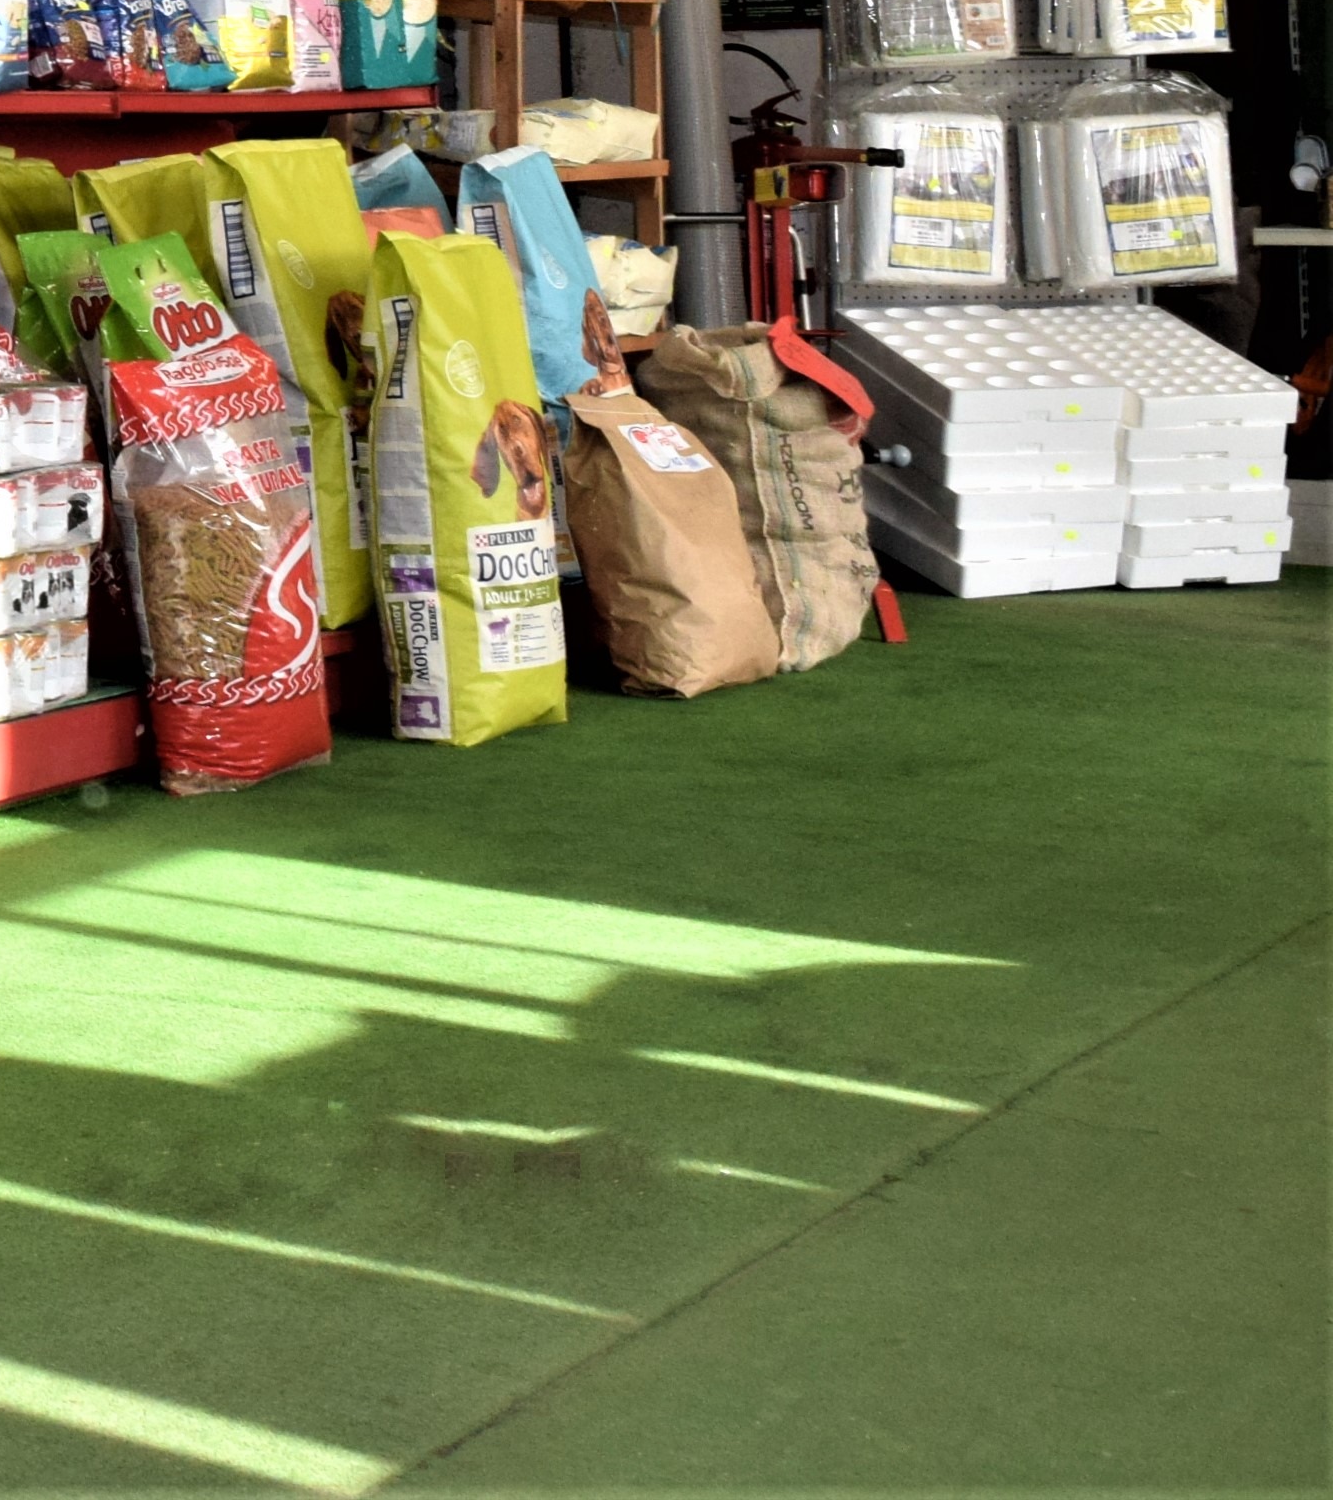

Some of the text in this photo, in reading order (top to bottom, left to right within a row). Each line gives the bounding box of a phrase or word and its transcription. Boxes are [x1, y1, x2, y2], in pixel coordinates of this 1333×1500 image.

[152, 300, 223, 351] Otto
[161, 358, 217, 382] Raggio
[778, 433, 815, 532] HZPC.COM
[489, 529, 534, 546] PURINA
[484, 590, 521, 605] ADULT
